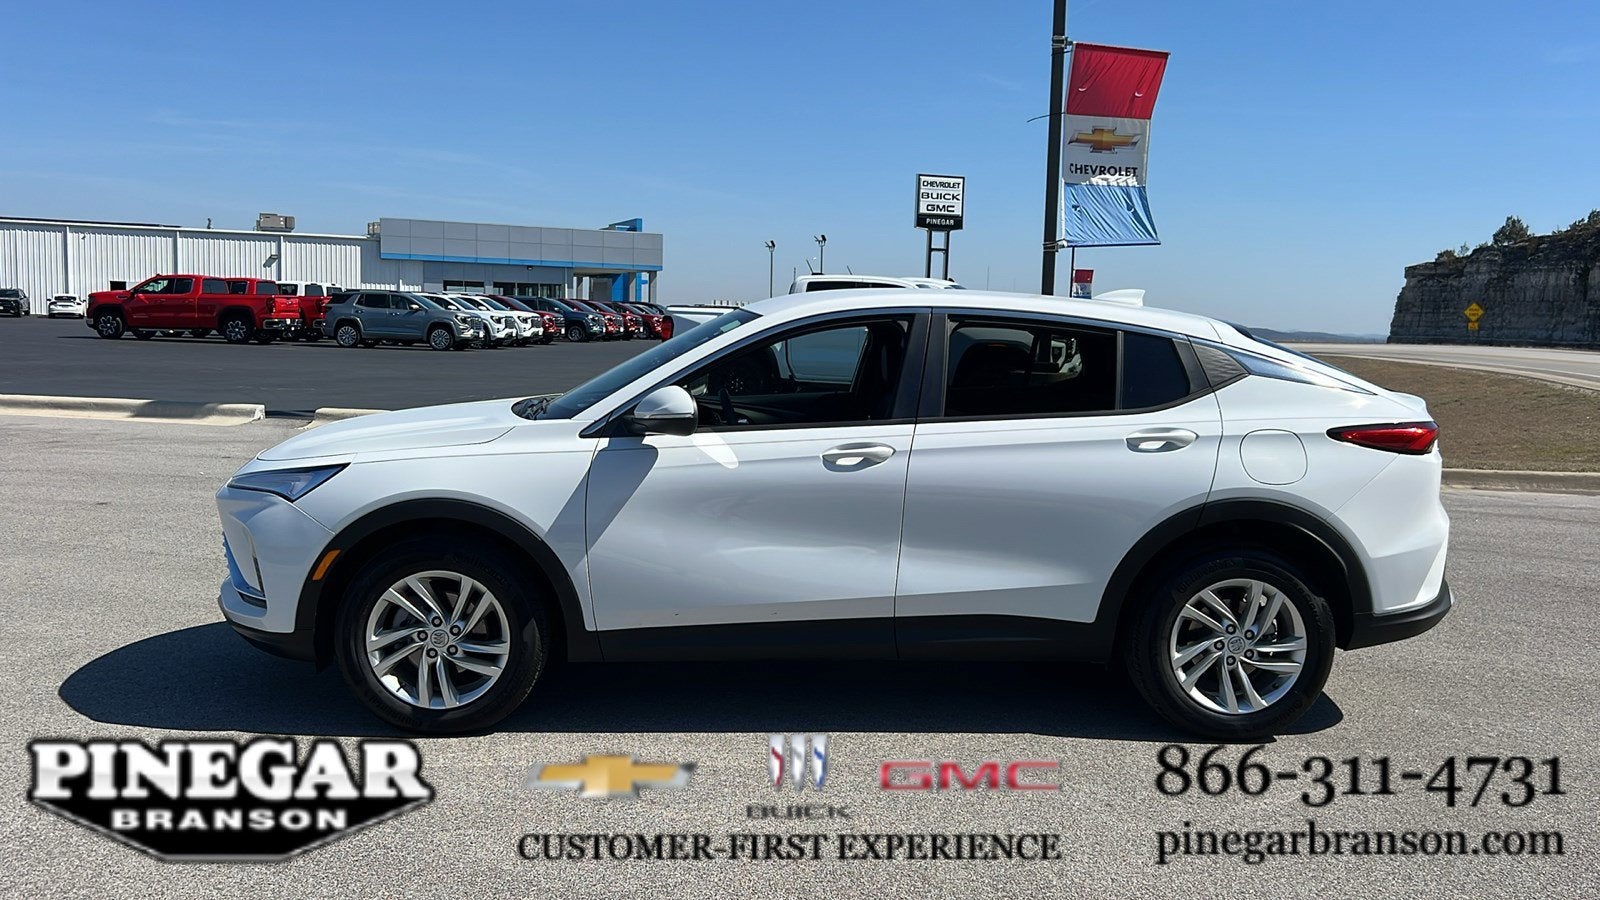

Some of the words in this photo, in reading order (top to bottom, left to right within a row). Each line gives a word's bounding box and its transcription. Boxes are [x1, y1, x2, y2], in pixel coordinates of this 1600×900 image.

[922, 180, 961, 189] CHEVROLET
[921, 192, 961, 201] BUICK
[926, 204, 956, 213] GMC
[926, 218, 955, 226] PINEGAR
